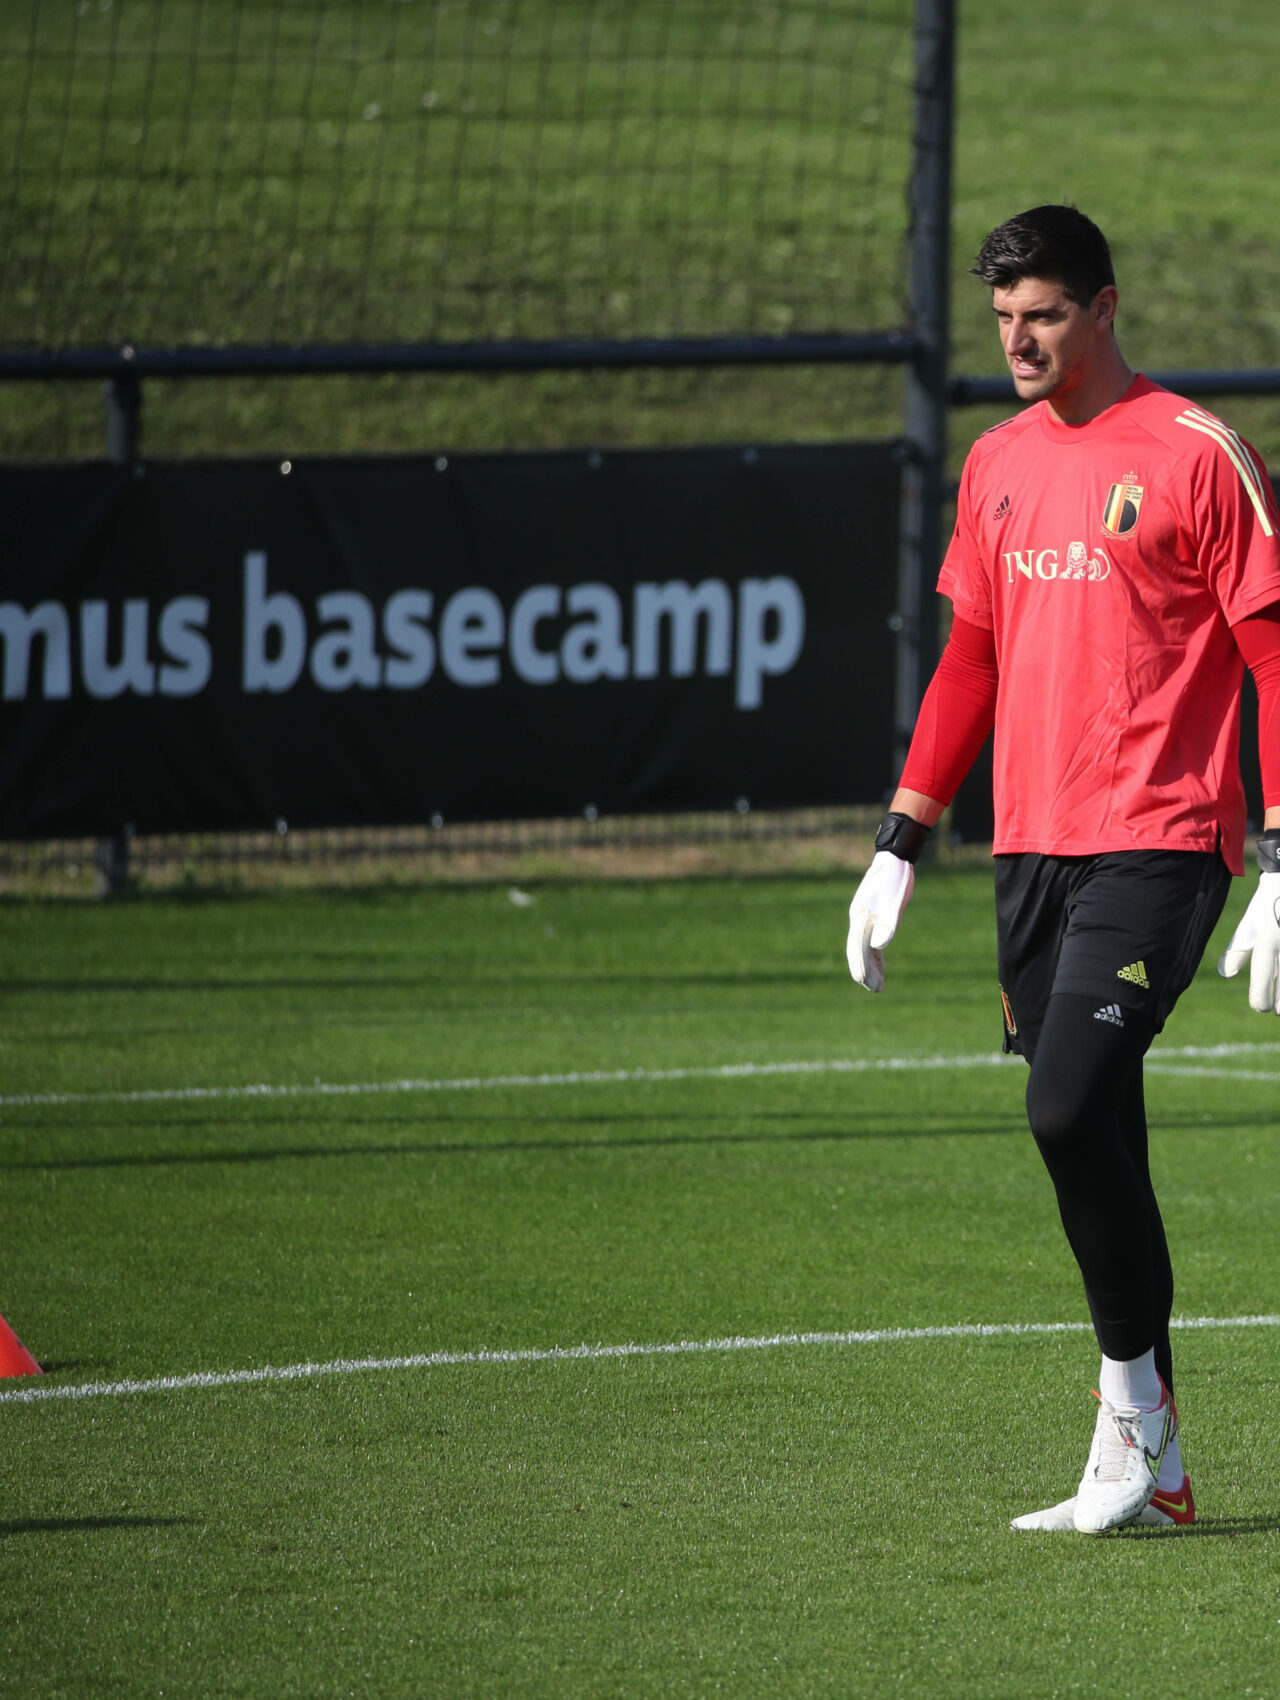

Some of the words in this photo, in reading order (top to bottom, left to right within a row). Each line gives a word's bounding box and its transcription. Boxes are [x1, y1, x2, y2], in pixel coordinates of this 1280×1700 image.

[1002, 548, 1059, 583] ING
[242, 551, 804, 709] basecamp
[1117, 969, 1150, 989] adidas
[1093, 1011, 1125, 1027] adidas
